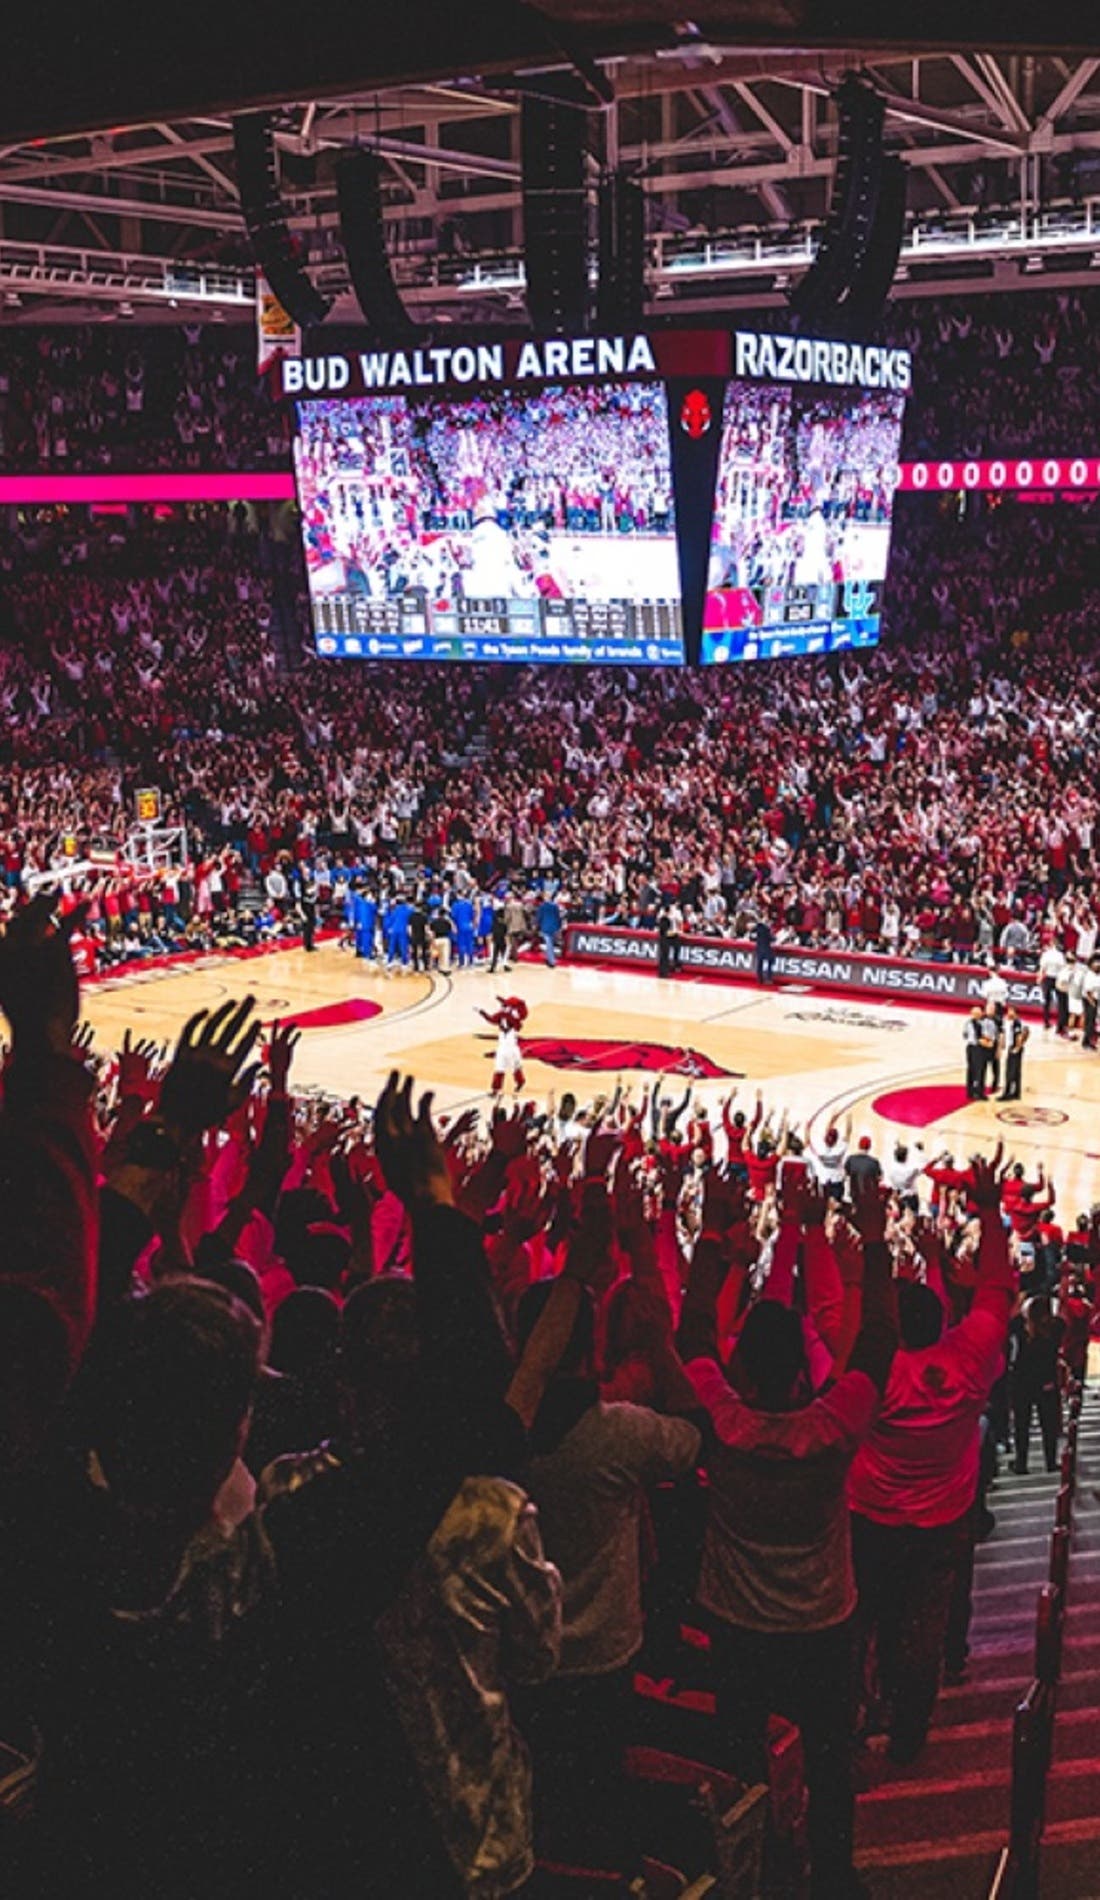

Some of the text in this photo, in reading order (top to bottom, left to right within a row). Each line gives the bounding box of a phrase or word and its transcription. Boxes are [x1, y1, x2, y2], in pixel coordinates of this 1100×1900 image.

[282, 335, 655, 392] BUD WALTON ARENA
[735, 331, 911, 389] RAZORBACKS
[577, 935, 658, 959] NISSAN
[862, 967, 955, 992] NISSAN
[967, 979, 1058, 1004] NSA
